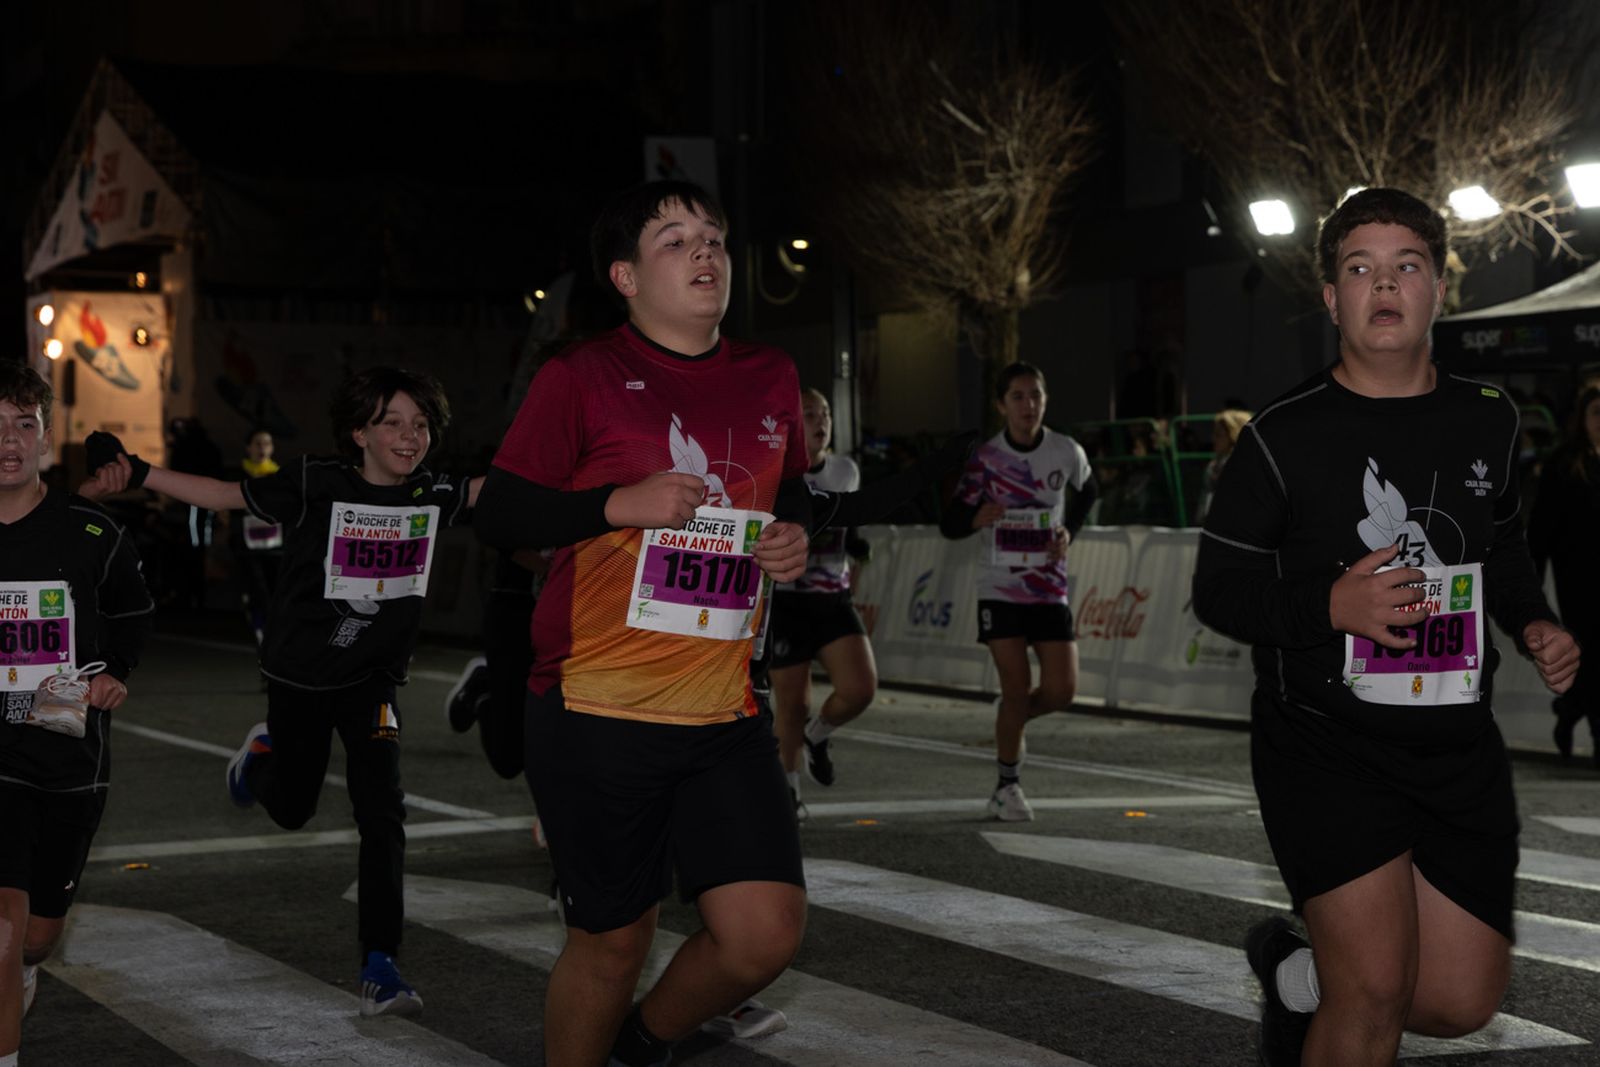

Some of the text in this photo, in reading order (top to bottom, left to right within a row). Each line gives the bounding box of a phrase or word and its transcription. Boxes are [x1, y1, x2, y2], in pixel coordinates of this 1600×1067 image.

[356, 516, 402, 527] NOCHE DE
[342, 527, 364, 537] SAN
[366, 528, 401, 539] ANTÓN
[721, 524, 736, 536] DE
[659, 533, 733, 553] SAN ANTÓN
[344, 540, 420, 568] 15512
[663, 551, 752, 596] 15170
[1429, 583, 1443, 596] DE
[14, 594, 28, 605] DE
[981, 607, 992, 631] 9
[7, 700, 32, 710] SAN
